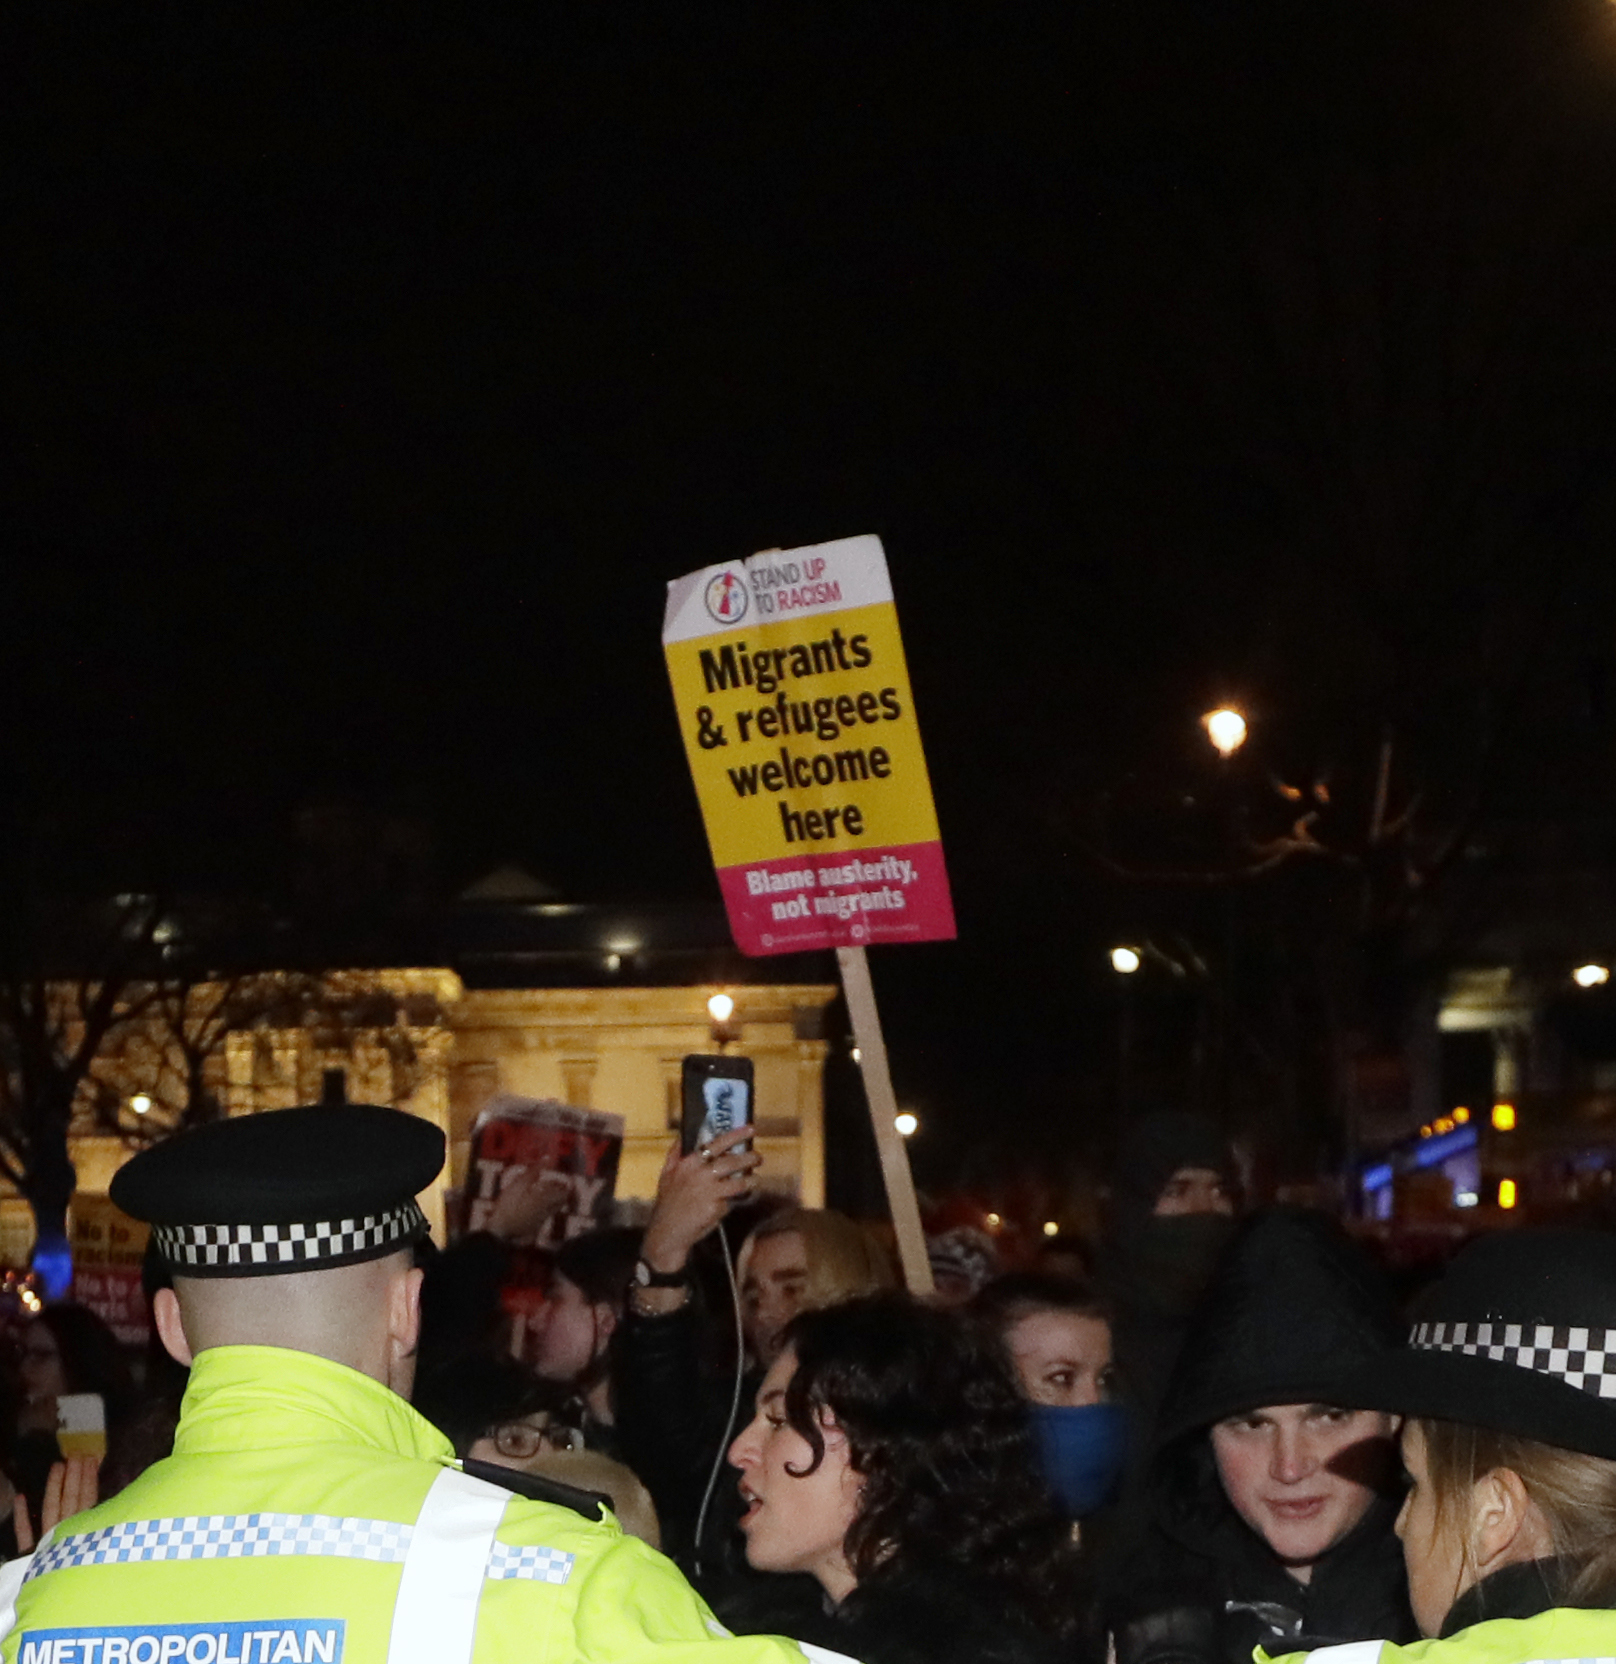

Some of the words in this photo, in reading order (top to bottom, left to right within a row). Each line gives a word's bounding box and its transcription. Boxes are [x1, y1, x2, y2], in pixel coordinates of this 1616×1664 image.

[750, 562, 801, 591] STAND
[801, 557, 826, 582] UP
[754, 592, 776, 614] TO
[775, 580, 843, 612] RACISM
[699, 628, 872, 693] Migrants
[696, 705, 728, 749] &
[736, 687, 901, 741] refugees
[727, 746, 892, 797] welcome
[779, 801, 864, 842] here
[745, 868, 816, 896] Blame
[817, 855, 919, 886] austerity,
[771, 893, 812, 921] not
[814, 885, 906, 920] migrants
